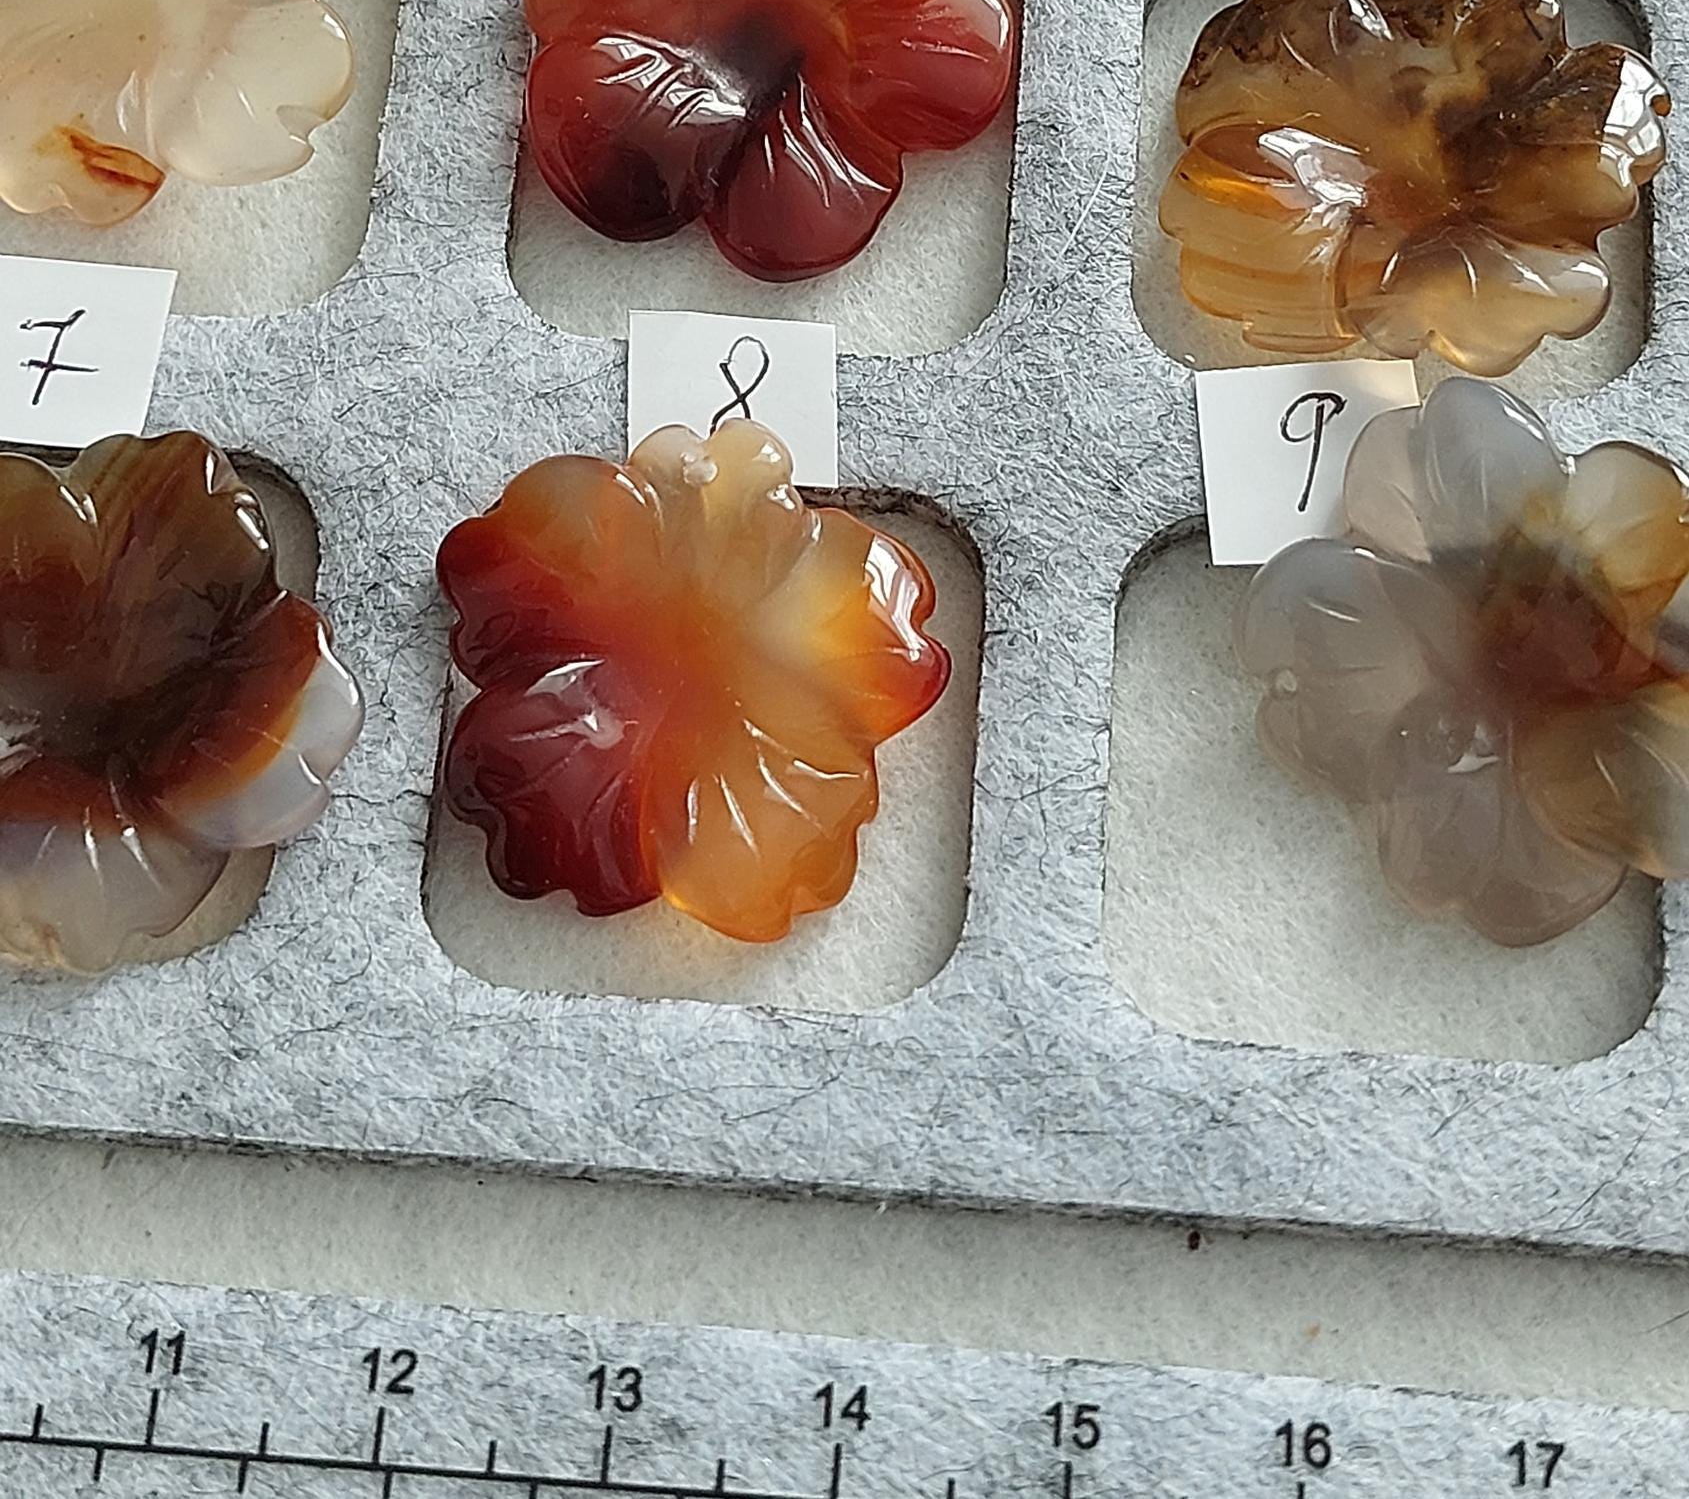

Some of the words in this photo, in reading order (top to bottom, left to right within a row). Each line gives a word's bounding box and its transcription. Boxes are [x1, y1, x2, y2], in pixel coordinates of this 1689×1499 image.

[19, 309, 99, 406] 7
[1280, 392, 1348, 512] 9
[138, 1328, 187, 1377] 11
[361, 1347, 418, 1395] 12
[587, 1364, 645, 1413] 13
[814, 1382, 871, 1431] 14
[1044, 1402, 1102, 1450] 15
[1275, 1419, 1333, 1469] 16
[1506, 1440, 1565, 1489] 17
